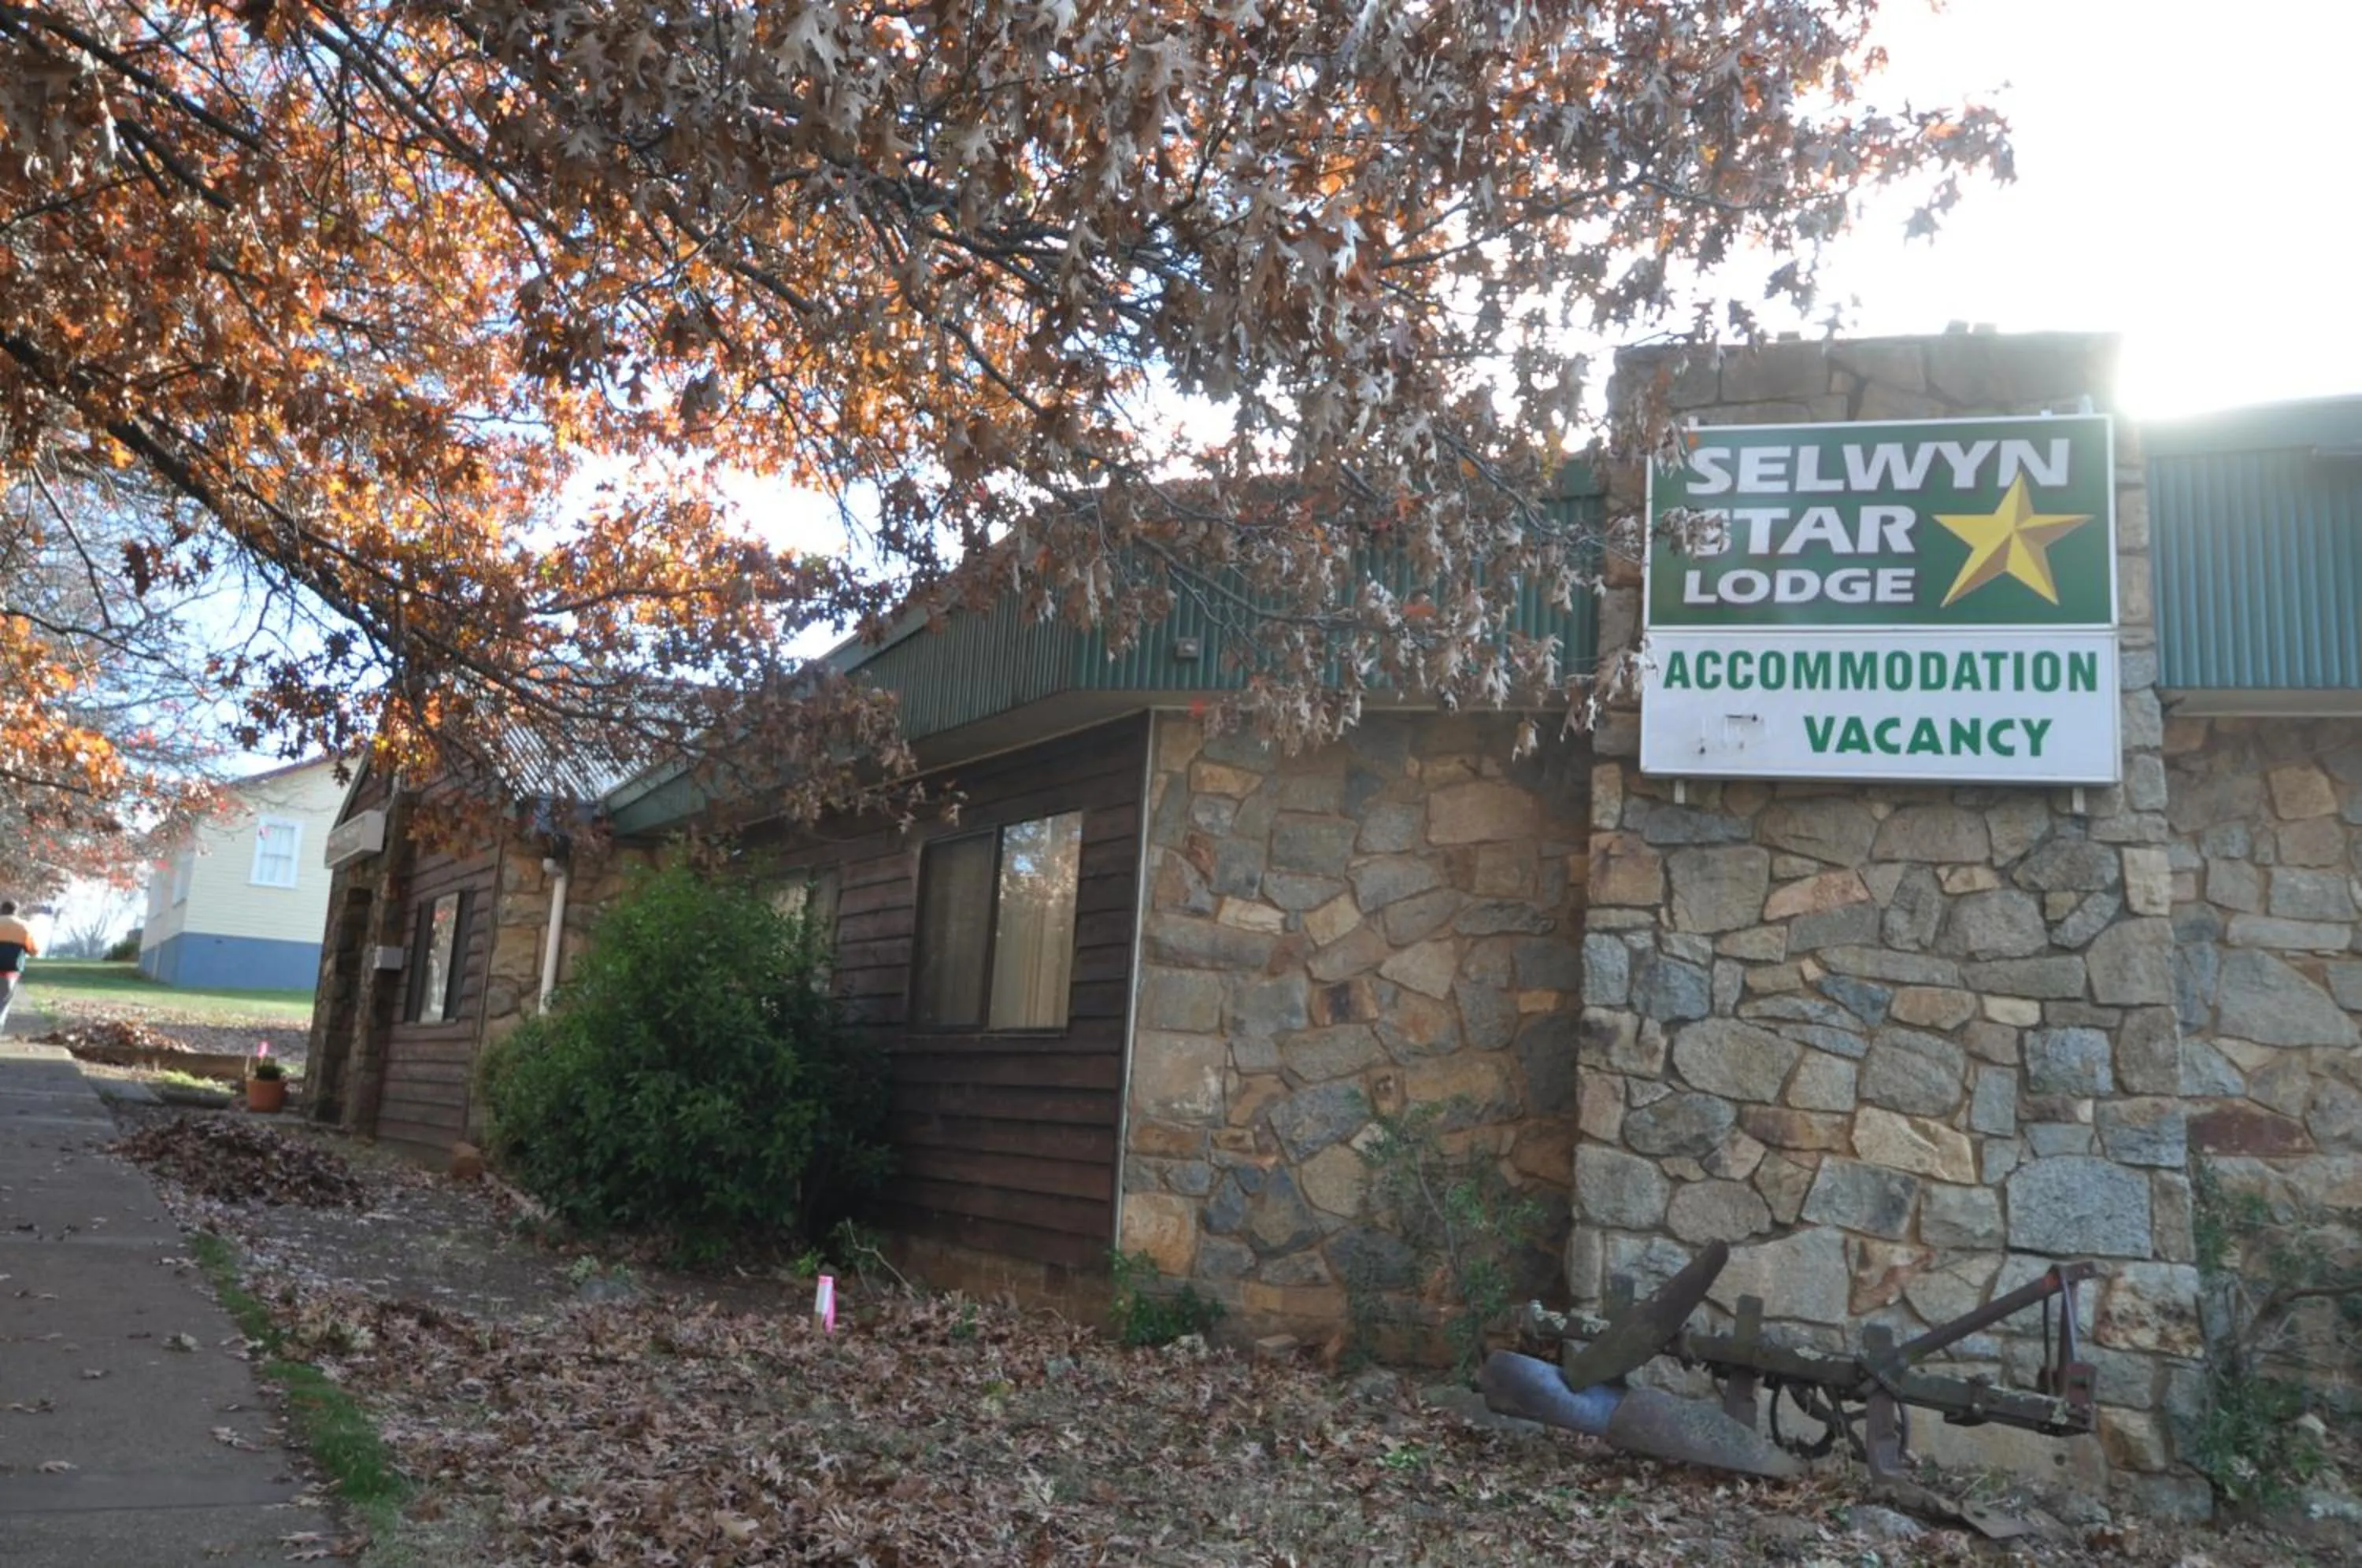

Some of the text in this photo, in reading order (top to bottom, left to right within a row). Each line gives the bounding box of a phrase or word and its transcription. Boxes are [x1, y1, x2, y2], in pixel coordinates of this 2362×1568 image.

[1686, 438, 2070, 494] SELWYN
[1683, 568, 1915, 604] LODGE
[1663, 649, 2097, 692] ACCOMMODATION
[1804, 715, 2053, 757] VACANCY
